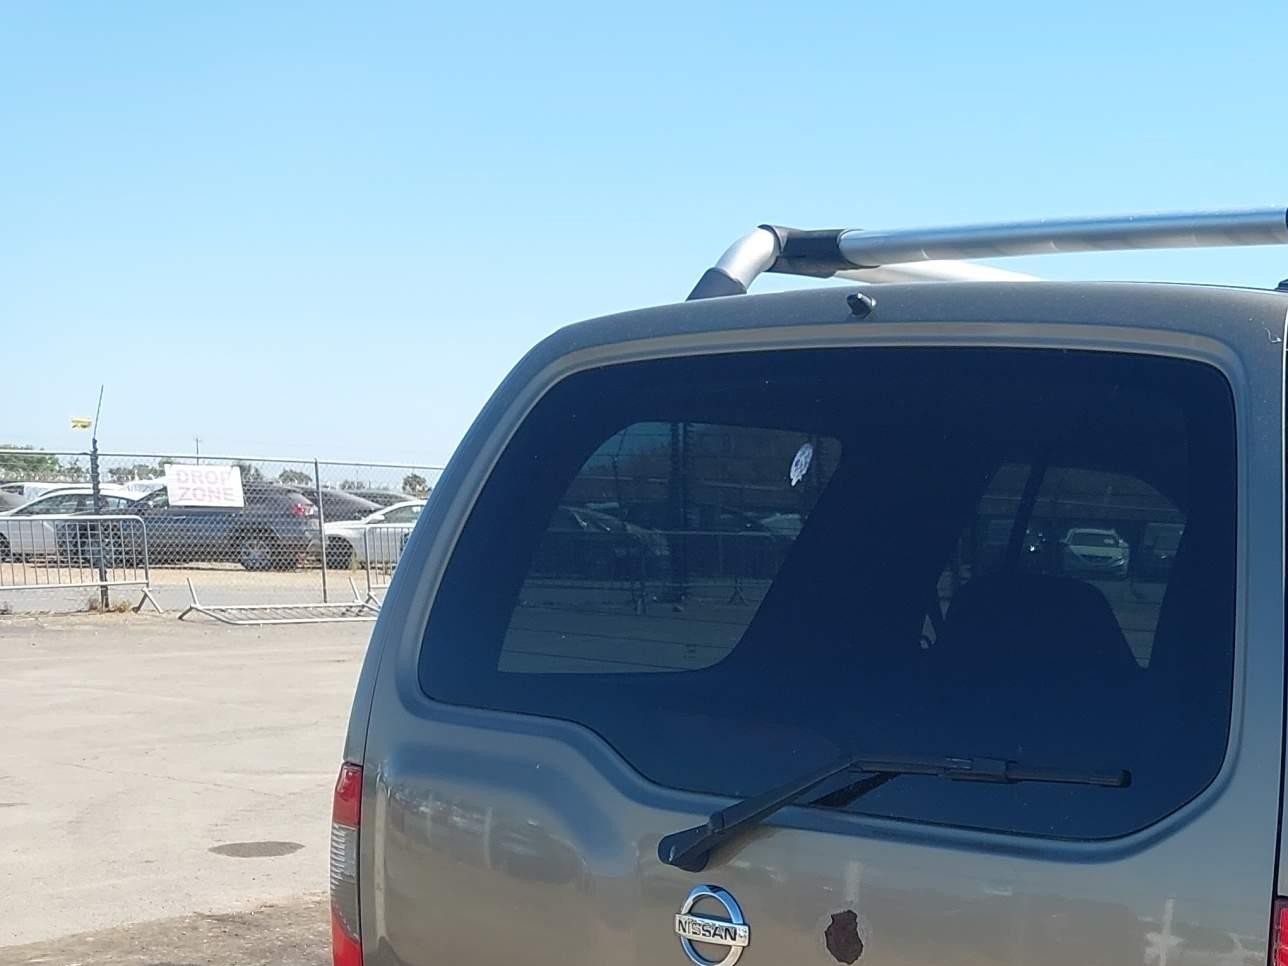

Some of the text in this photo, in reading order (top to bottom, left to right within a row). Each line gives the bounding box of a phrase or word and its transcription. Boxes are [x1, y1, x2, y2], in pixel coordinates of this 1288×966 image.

[175, 469, 232, 485] DROP
[178, 486, 236, 502] ZONE
[678, 919, 738, 942] NISSAN
